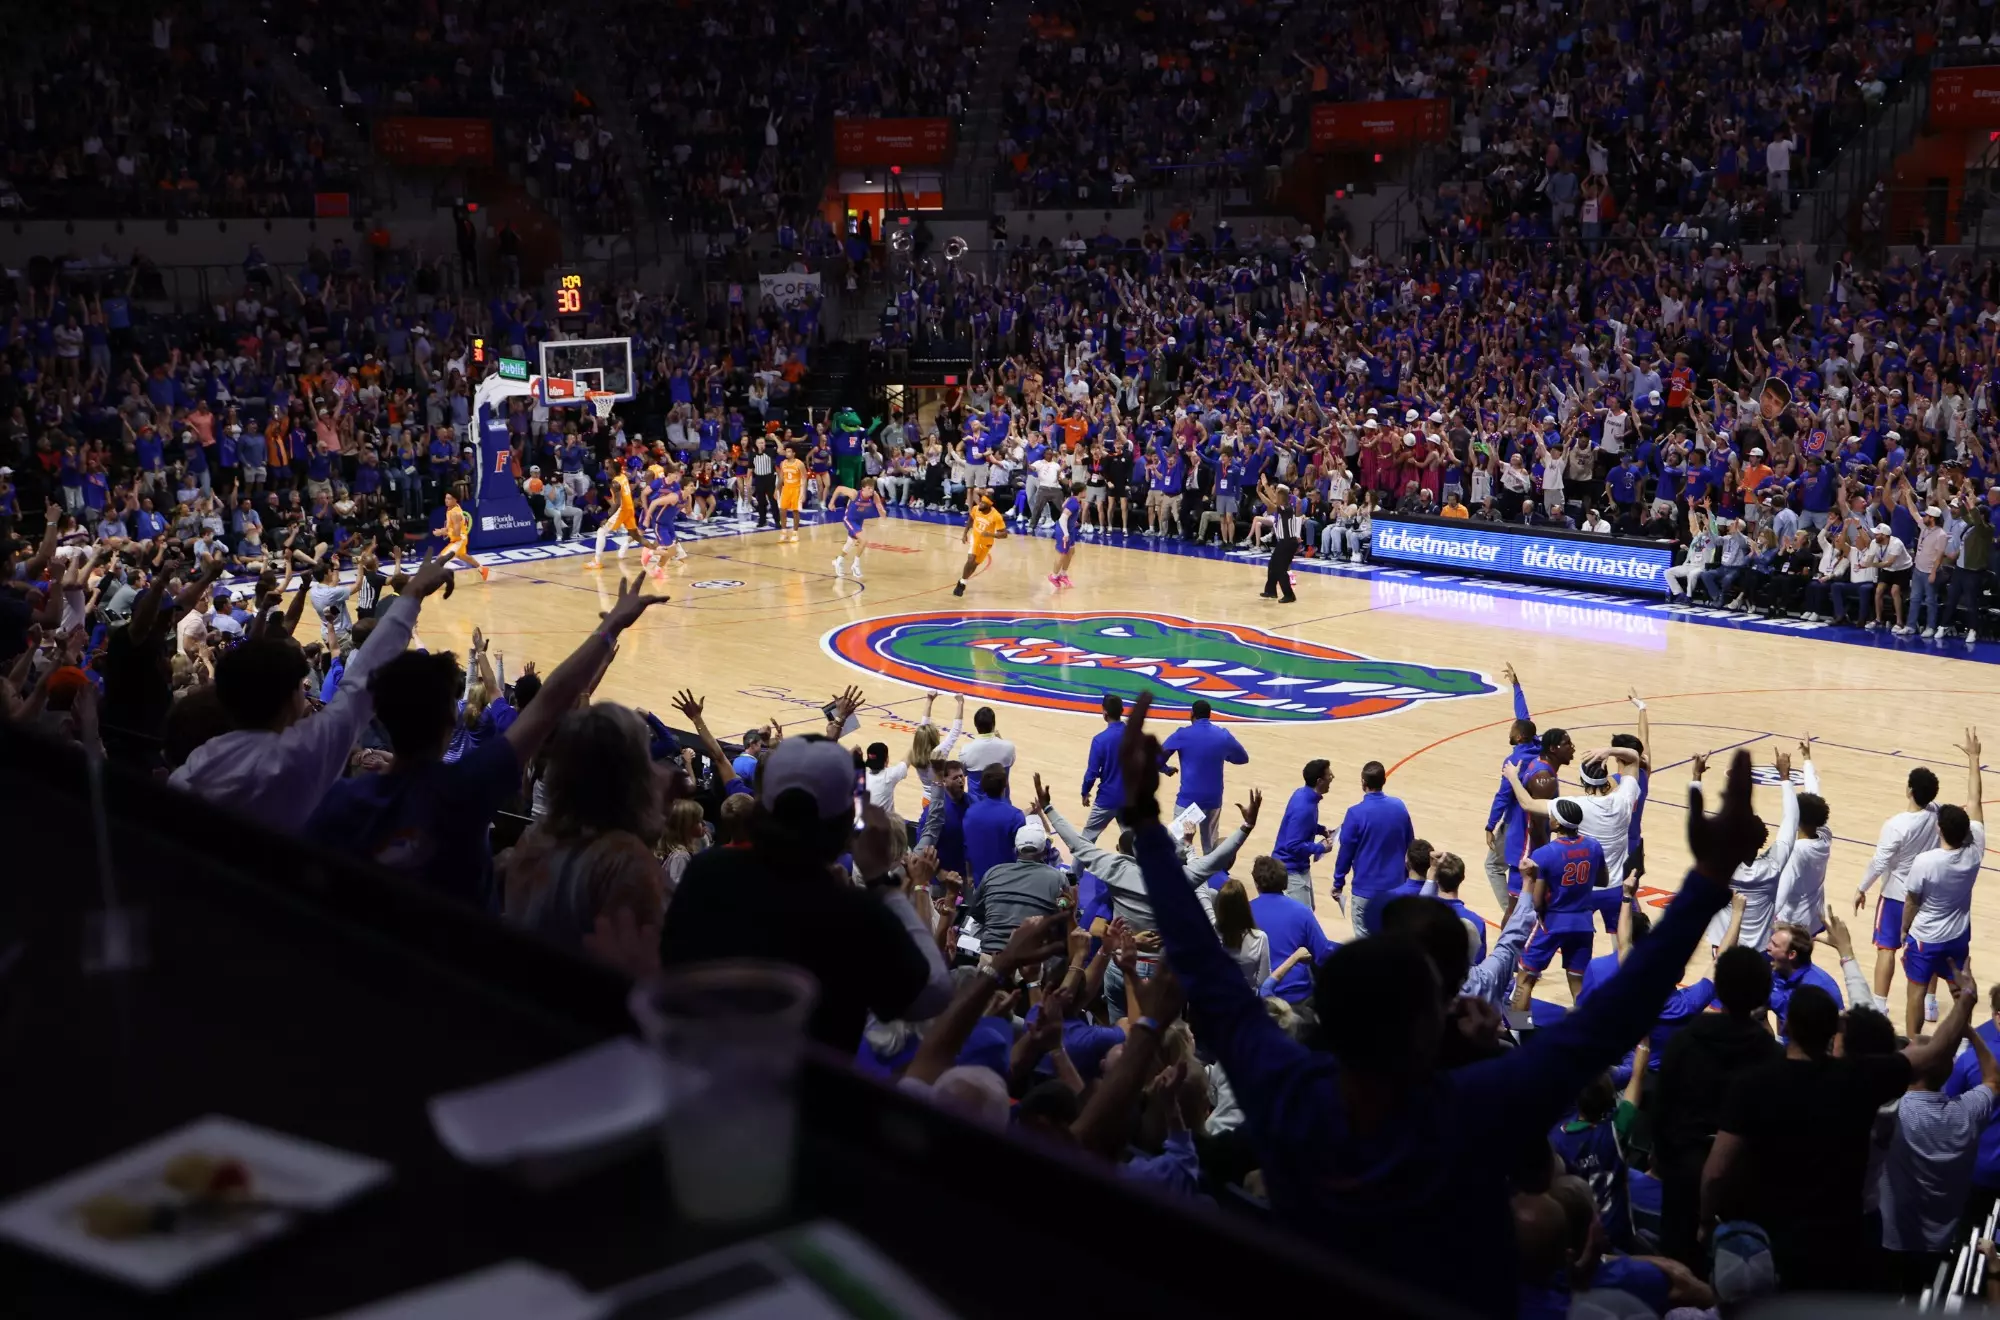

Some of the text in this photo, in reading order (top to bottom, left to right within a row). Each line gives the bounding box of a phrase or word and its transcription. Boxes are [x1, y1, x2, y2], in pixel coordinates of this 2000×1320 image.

[557, 288, 581, 313] 30
[499, 361, 525, 376] Publix
[1808, 431, 1826, 451] 3
[493, 450, 510, 474] F
[493, 513, 514, 523] Florida
[493, 520, 531, 530] Credit Union
[1378, 527, 1662, 580] ticketmaster ticketmaster
[1561, 860, 1591, 887] 20
